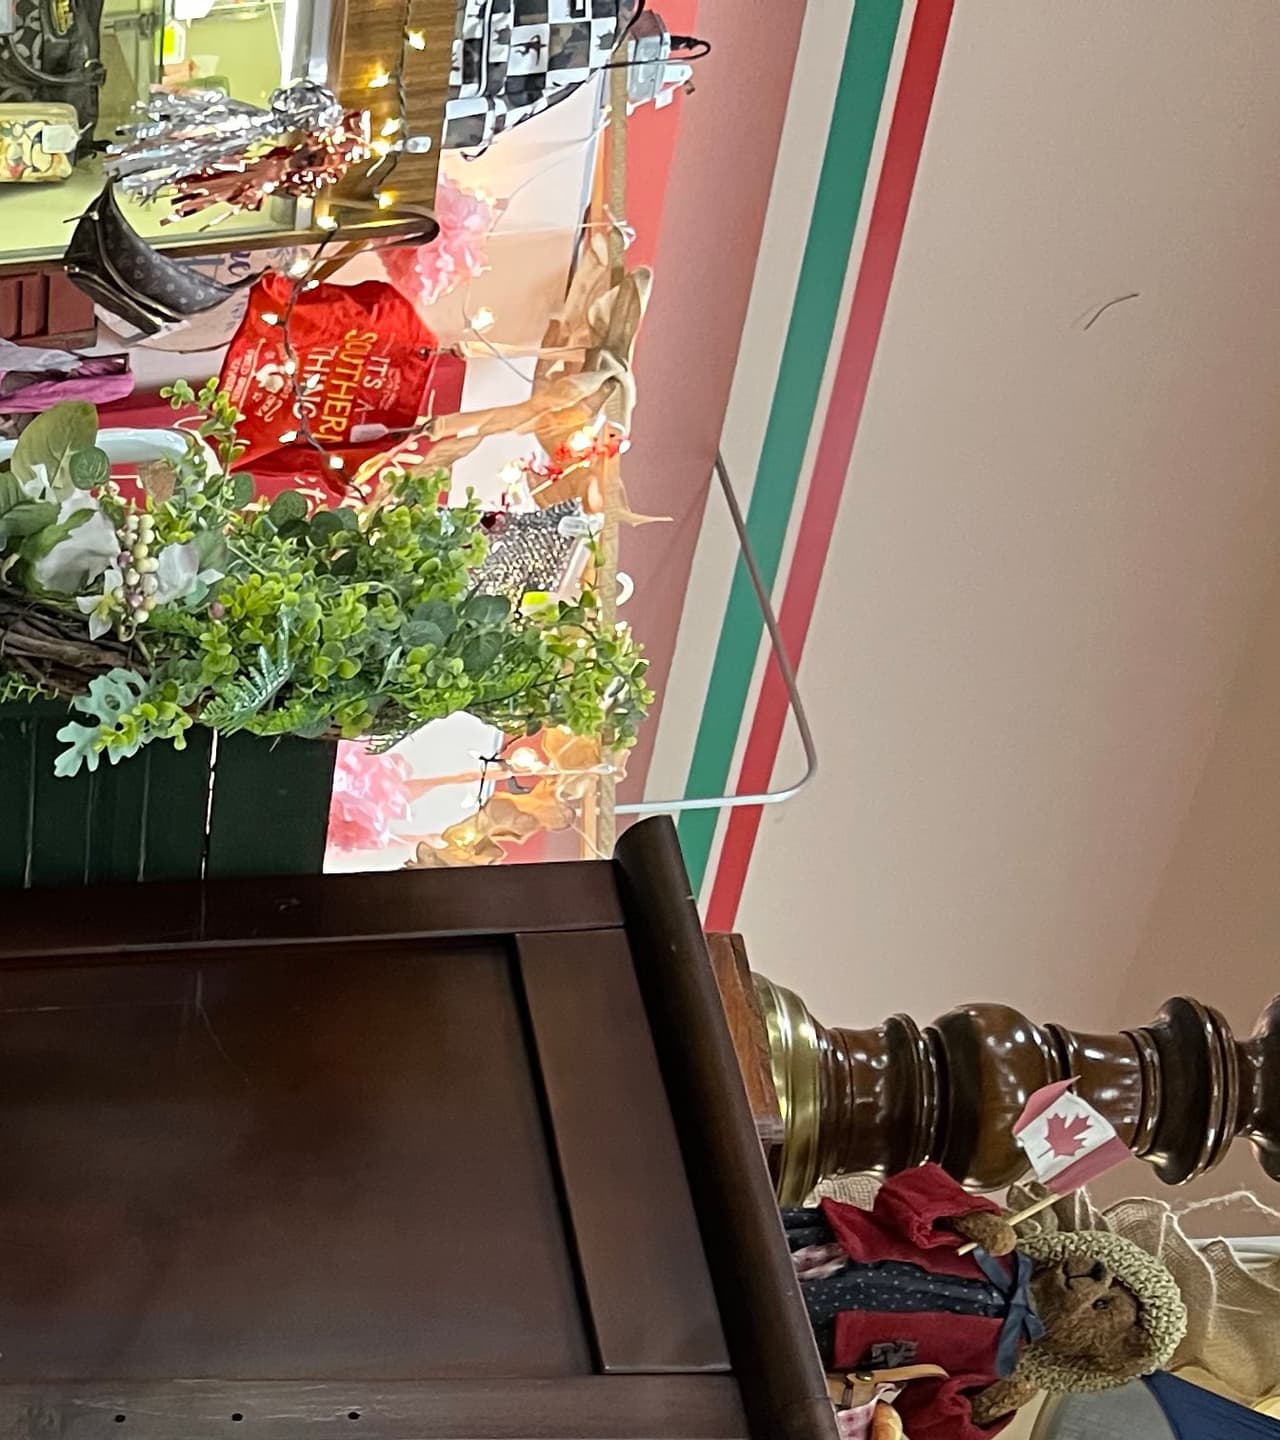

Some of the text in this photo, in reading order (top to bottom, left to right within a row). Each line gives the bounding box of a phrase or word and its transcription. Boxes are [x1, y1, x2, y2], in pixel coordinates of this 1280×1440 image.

[293, 345, 339, 420] THING
[354, 356, 391, 412] IT'S A
